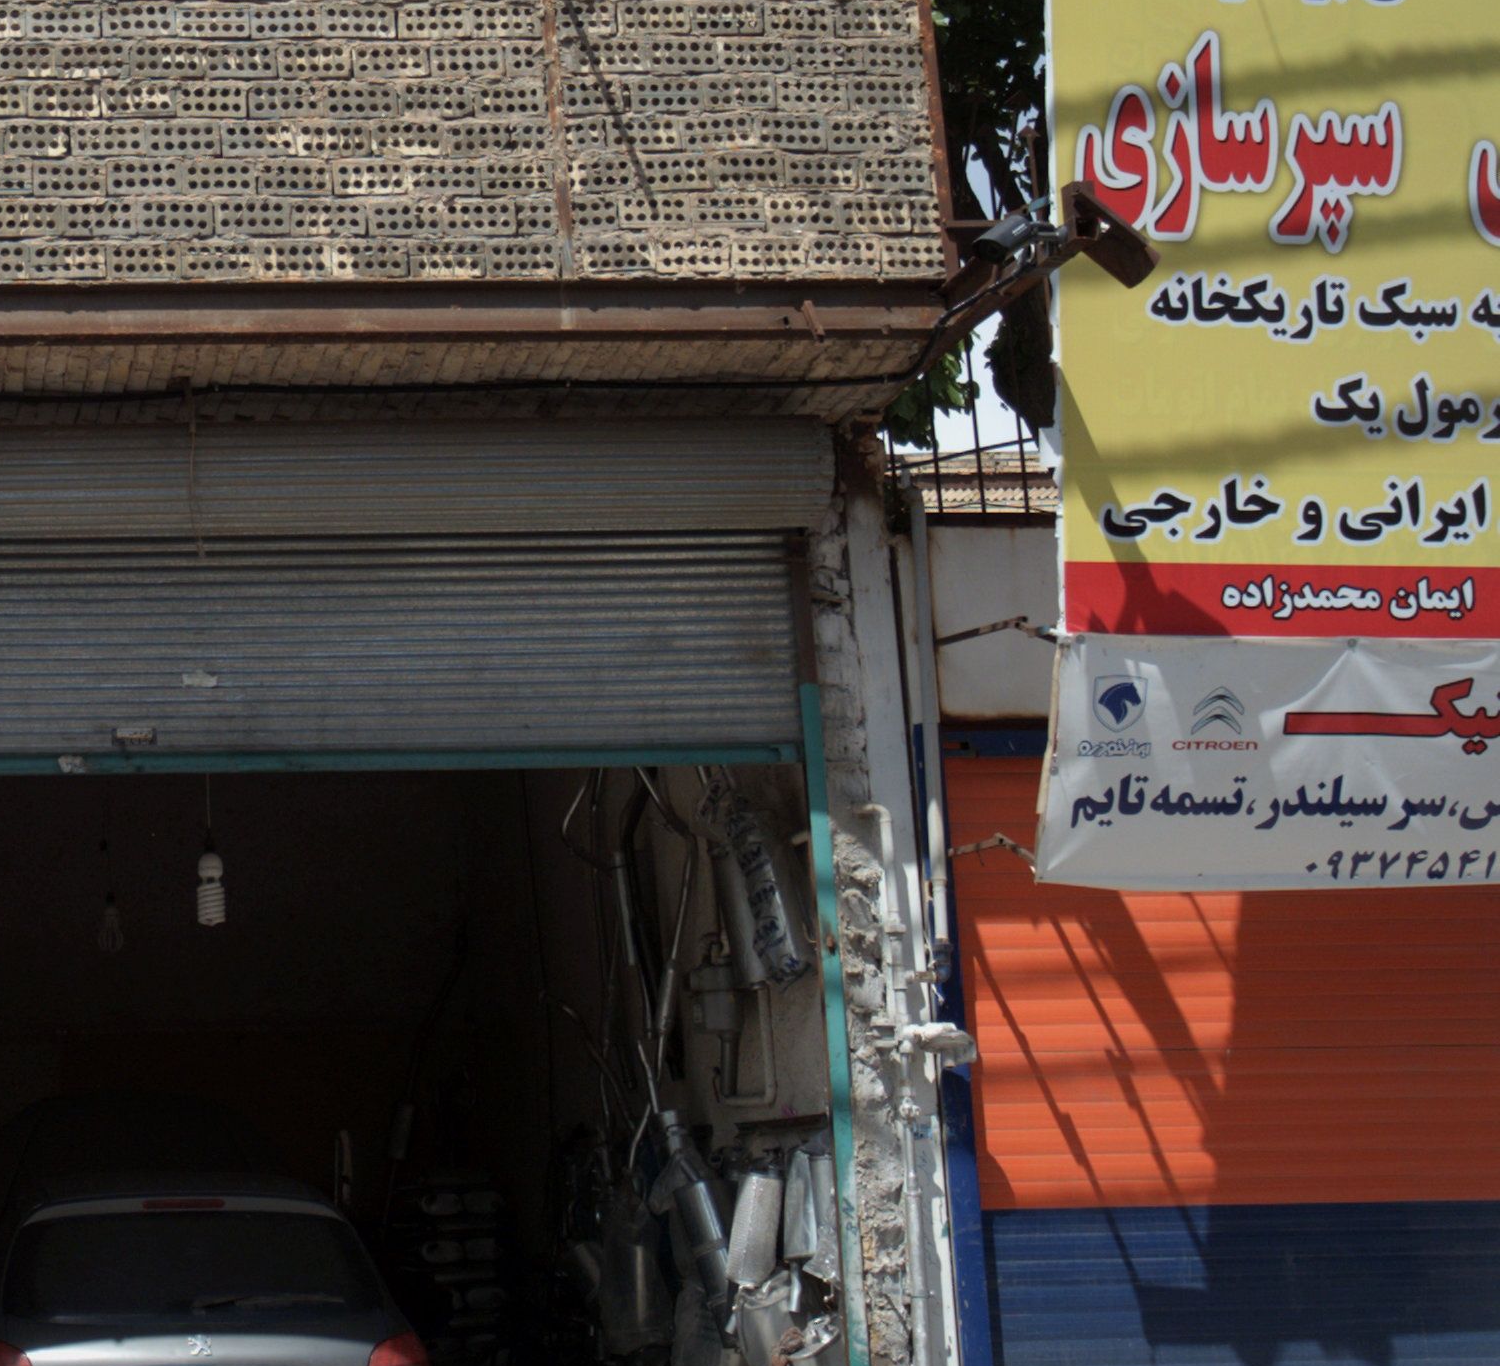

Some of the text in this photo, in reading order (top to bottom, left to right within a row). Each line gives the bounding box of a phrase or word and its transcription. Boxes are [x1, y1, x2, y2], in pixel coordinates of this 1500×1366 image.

[1356, 281, 1459, 340] سبک
[1313, 376, 1382, 435] یک
[1102, 477, 1487, 543] ایرانی و خارجی
[1221, 575, 1475, 620] ایمان محمدزاده
[1070, 773, 1150, 829] تایم
